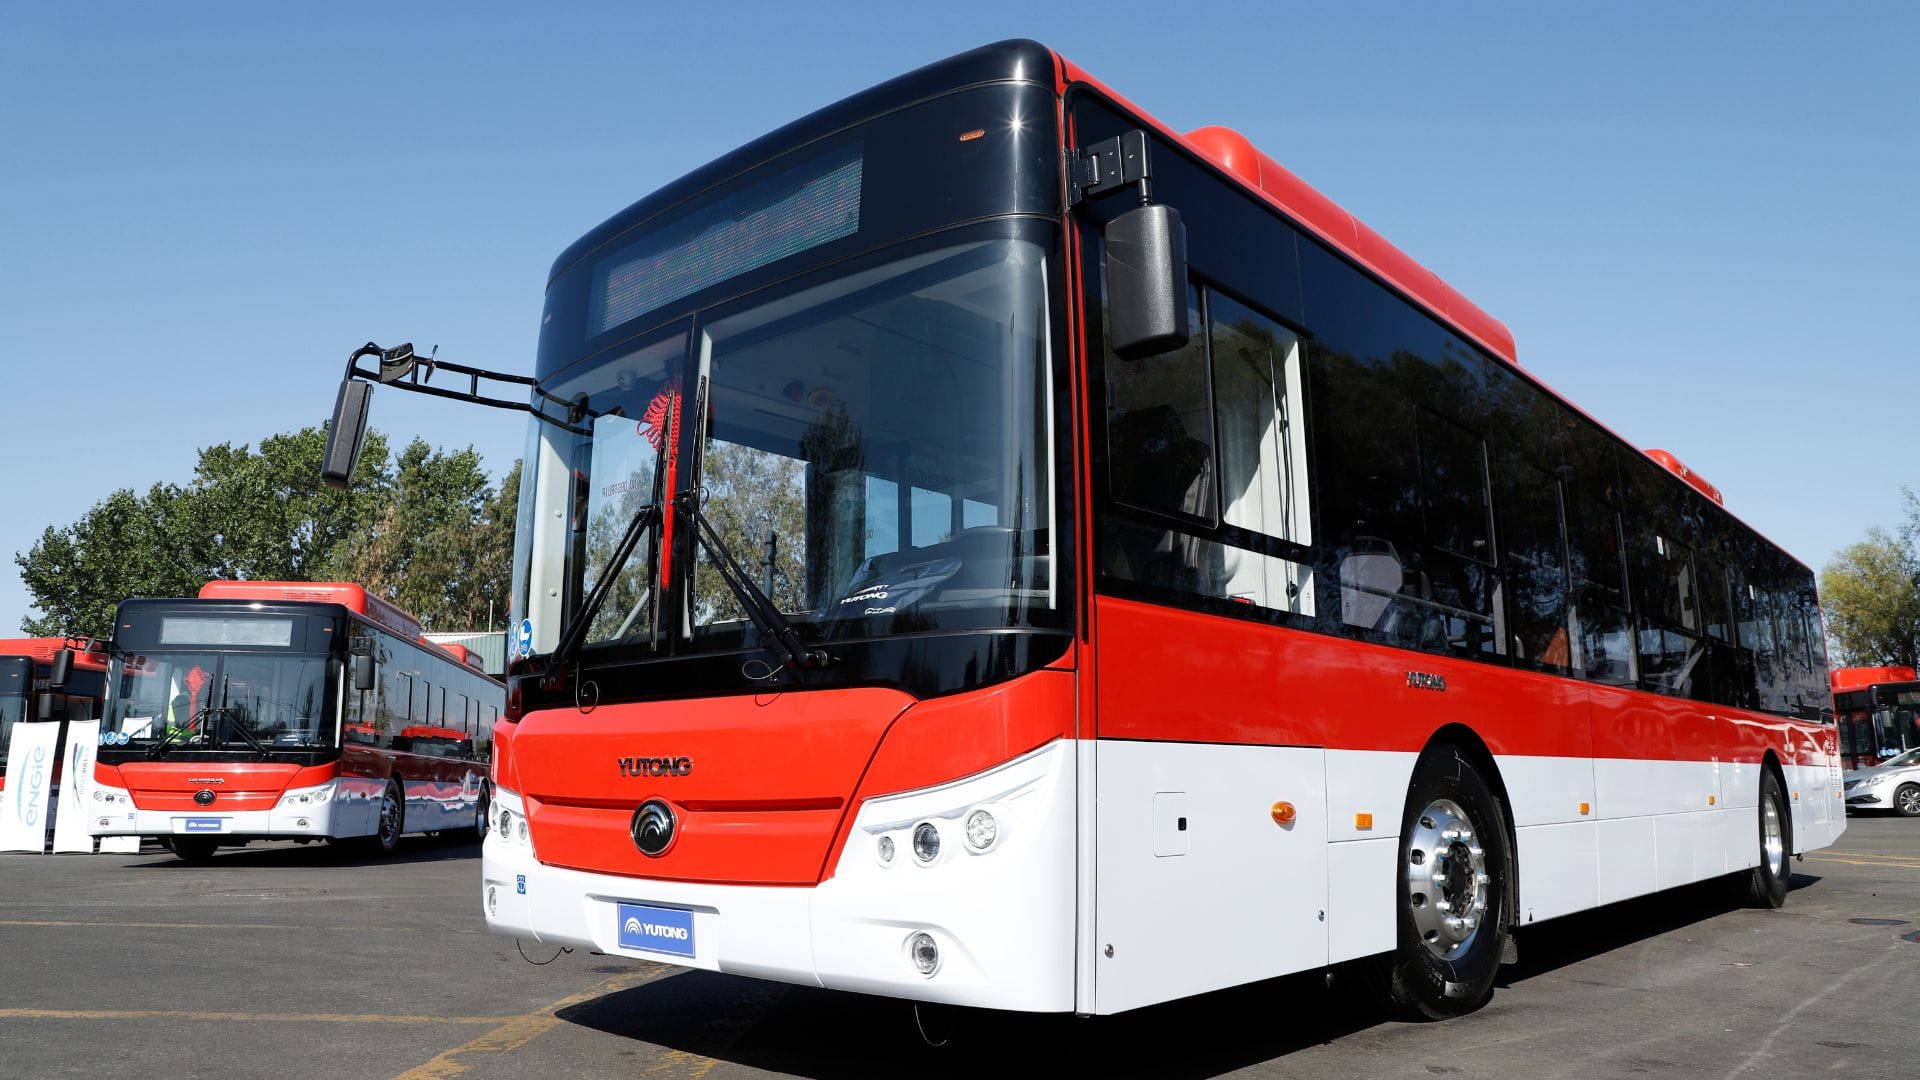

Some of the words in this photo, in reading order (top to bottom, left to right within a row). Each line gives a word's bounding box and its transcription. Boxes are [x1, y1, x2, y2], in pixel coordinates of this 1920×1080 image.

[840, 591, 889, 605] YUTONG
[1406, 671, 1446, 692] YUTONG
[617, 756, 692, 777] YUTONG
[643, 923, 688, 940] YUTONG
